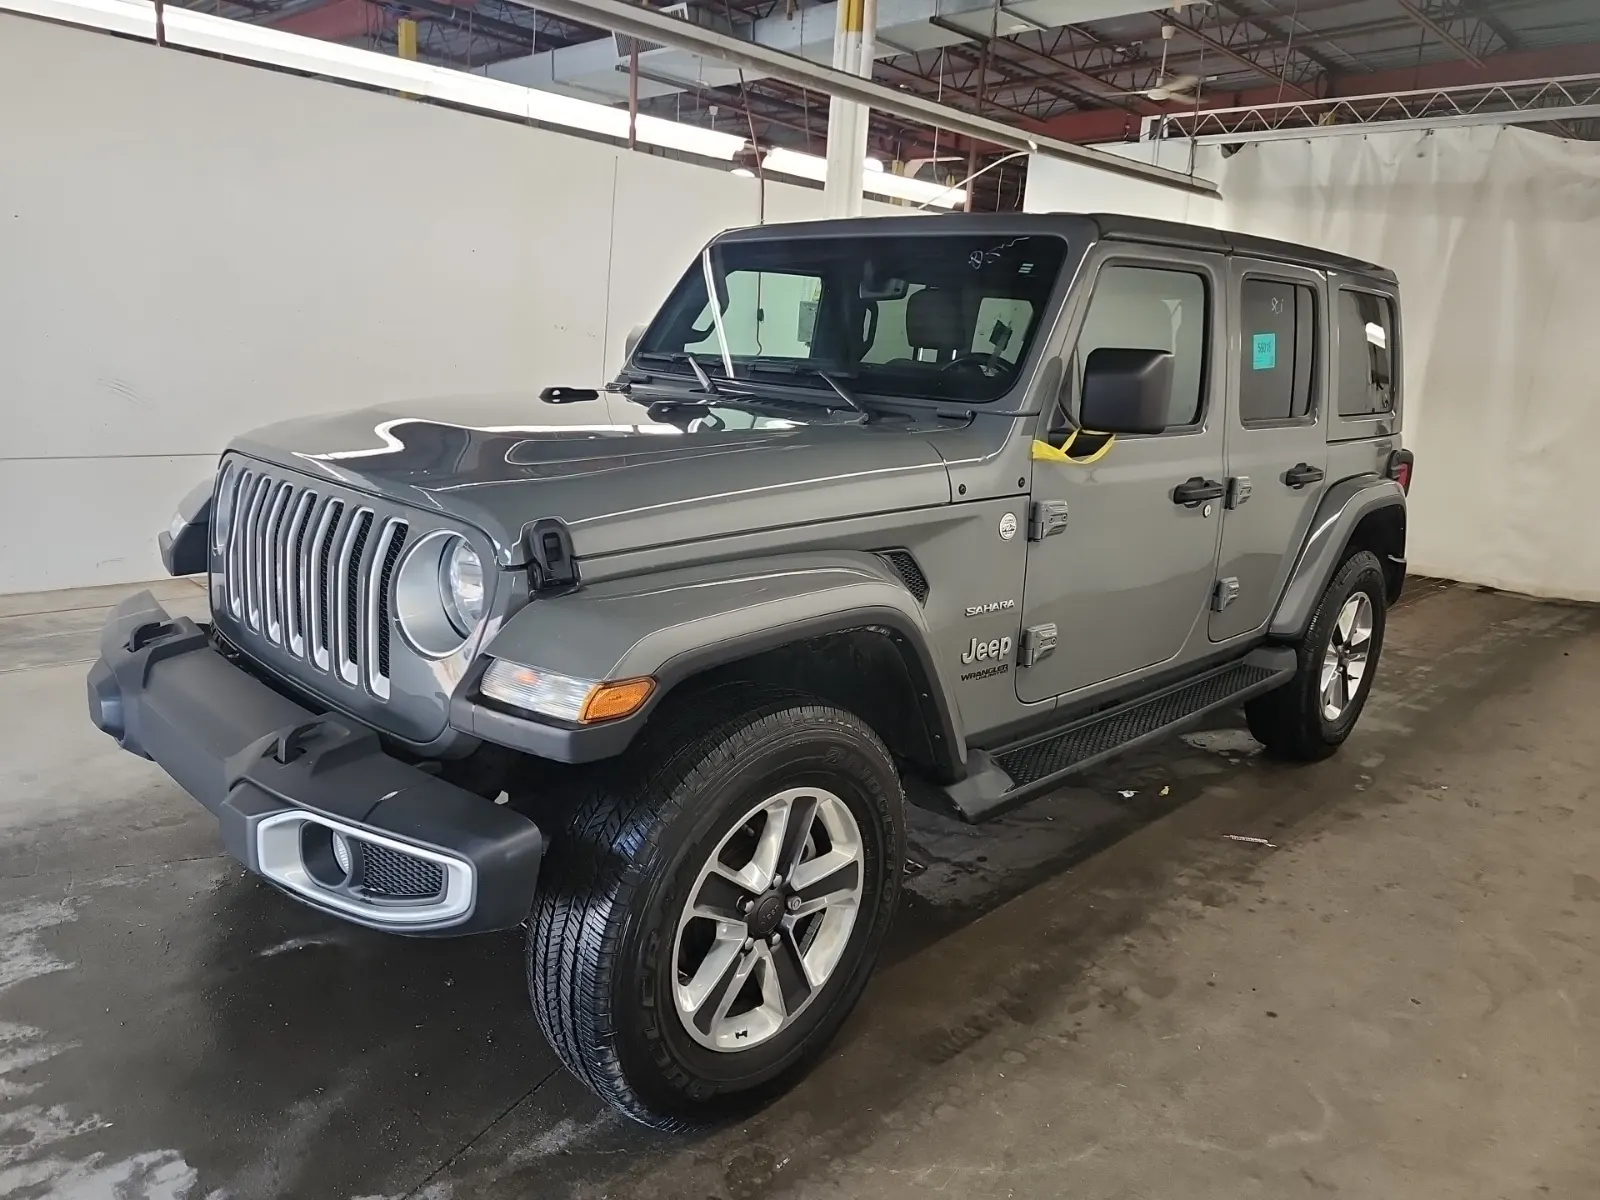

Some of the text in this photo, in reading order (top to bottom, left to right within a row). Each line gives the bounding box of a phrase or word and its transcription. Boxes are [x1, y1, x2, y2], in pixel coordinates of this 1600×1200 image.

[965, 600, 1015, 616] SAHARA
[961, 636, 1012, 665] Jeep
[961, 664, 1009, 681] WRANGLER
[821, 745, 896, 938] BRIDGESTON
